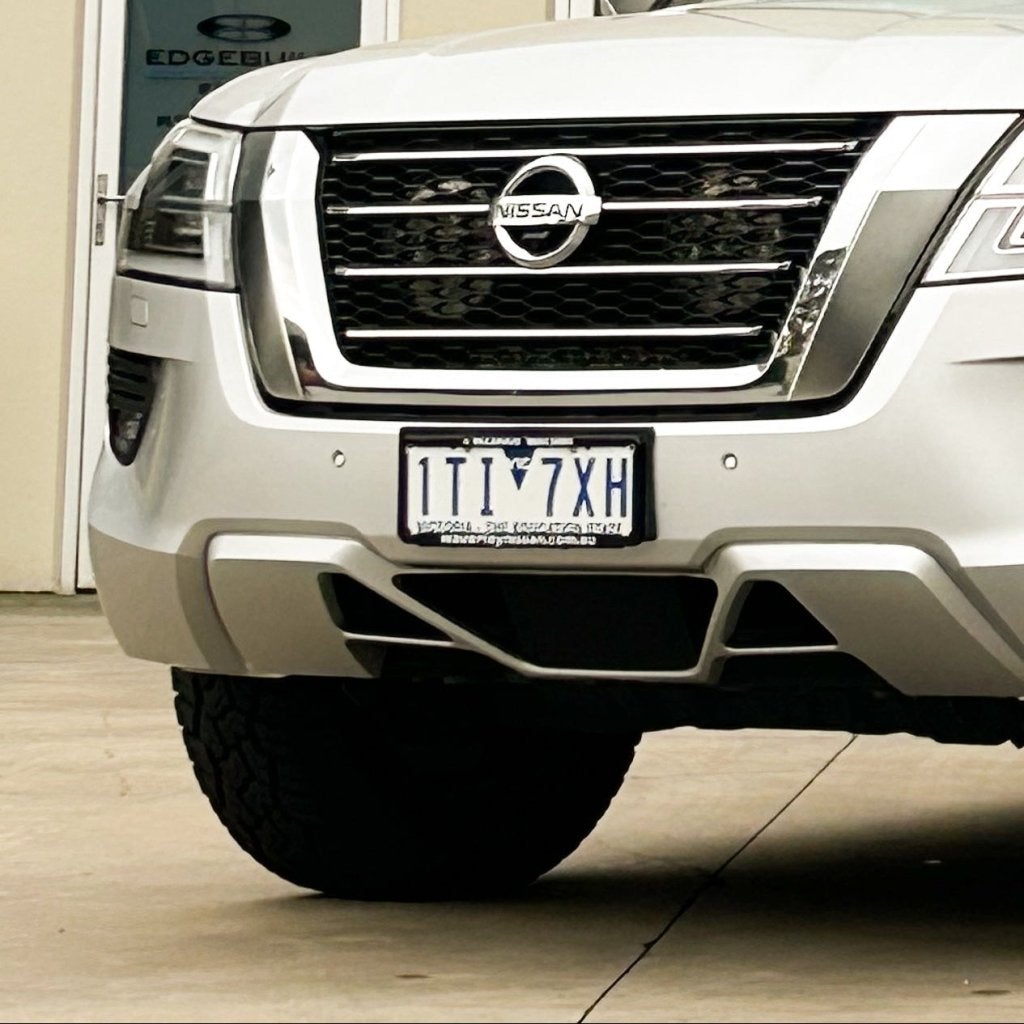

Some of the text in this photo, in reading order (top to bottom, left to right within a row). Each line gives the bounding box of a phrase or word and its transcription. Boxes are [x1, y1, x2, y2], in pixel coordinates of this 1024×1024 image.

[496, 202, 584, 219] NISSAN
[418, 457, 628, 518] 1TI 7XH
